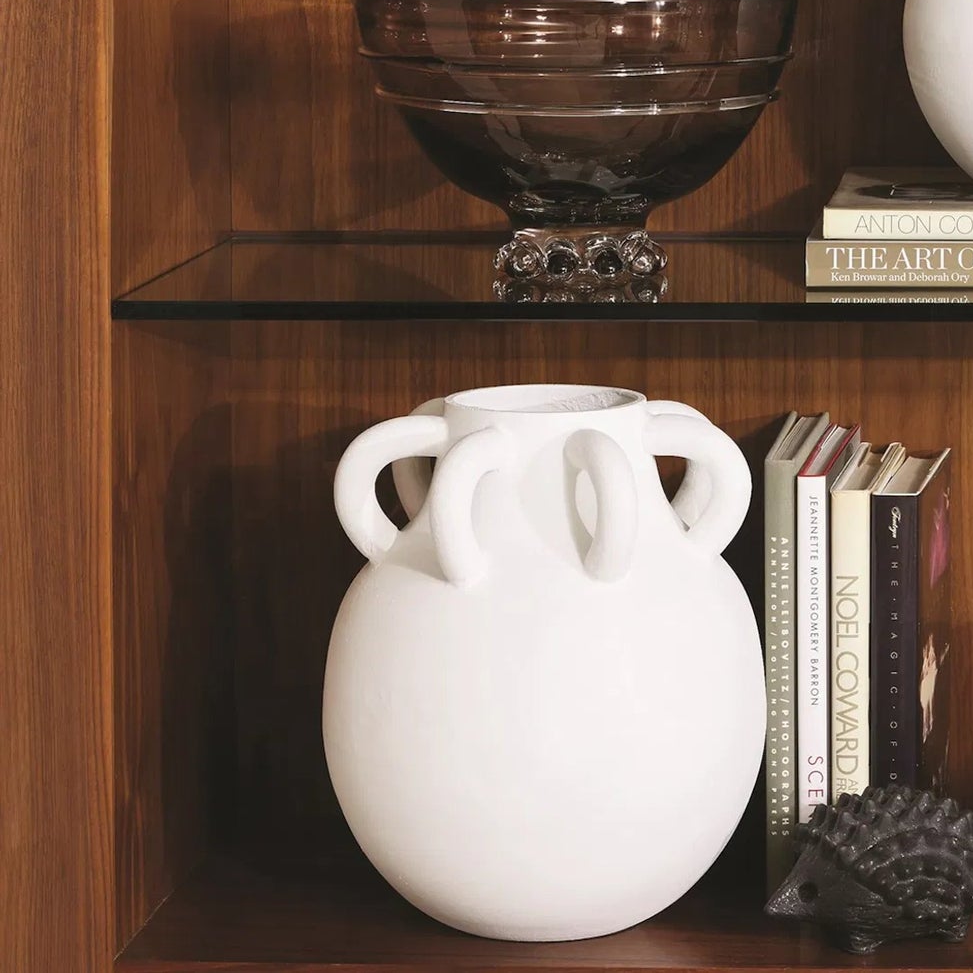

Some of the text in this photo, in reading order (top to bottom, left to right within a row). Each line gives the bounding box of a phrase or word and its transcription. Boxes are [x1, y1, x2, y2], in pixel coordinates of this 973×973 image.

[854, 214, 931, 235] ANTON
[825, 247, 888, 270] THE
[893, 247, 953, 270] ART
[831, 272, 970, 284] Ken Browar and Deborah Ory
[781, 536, 790, 590] ANNIE
[809, 495, 819, 706] JEANNETTE MONTGOMERY BARRON
[835, 575, 859, 775] NOEL COWARD
[848, 778, 859, 795] AN
